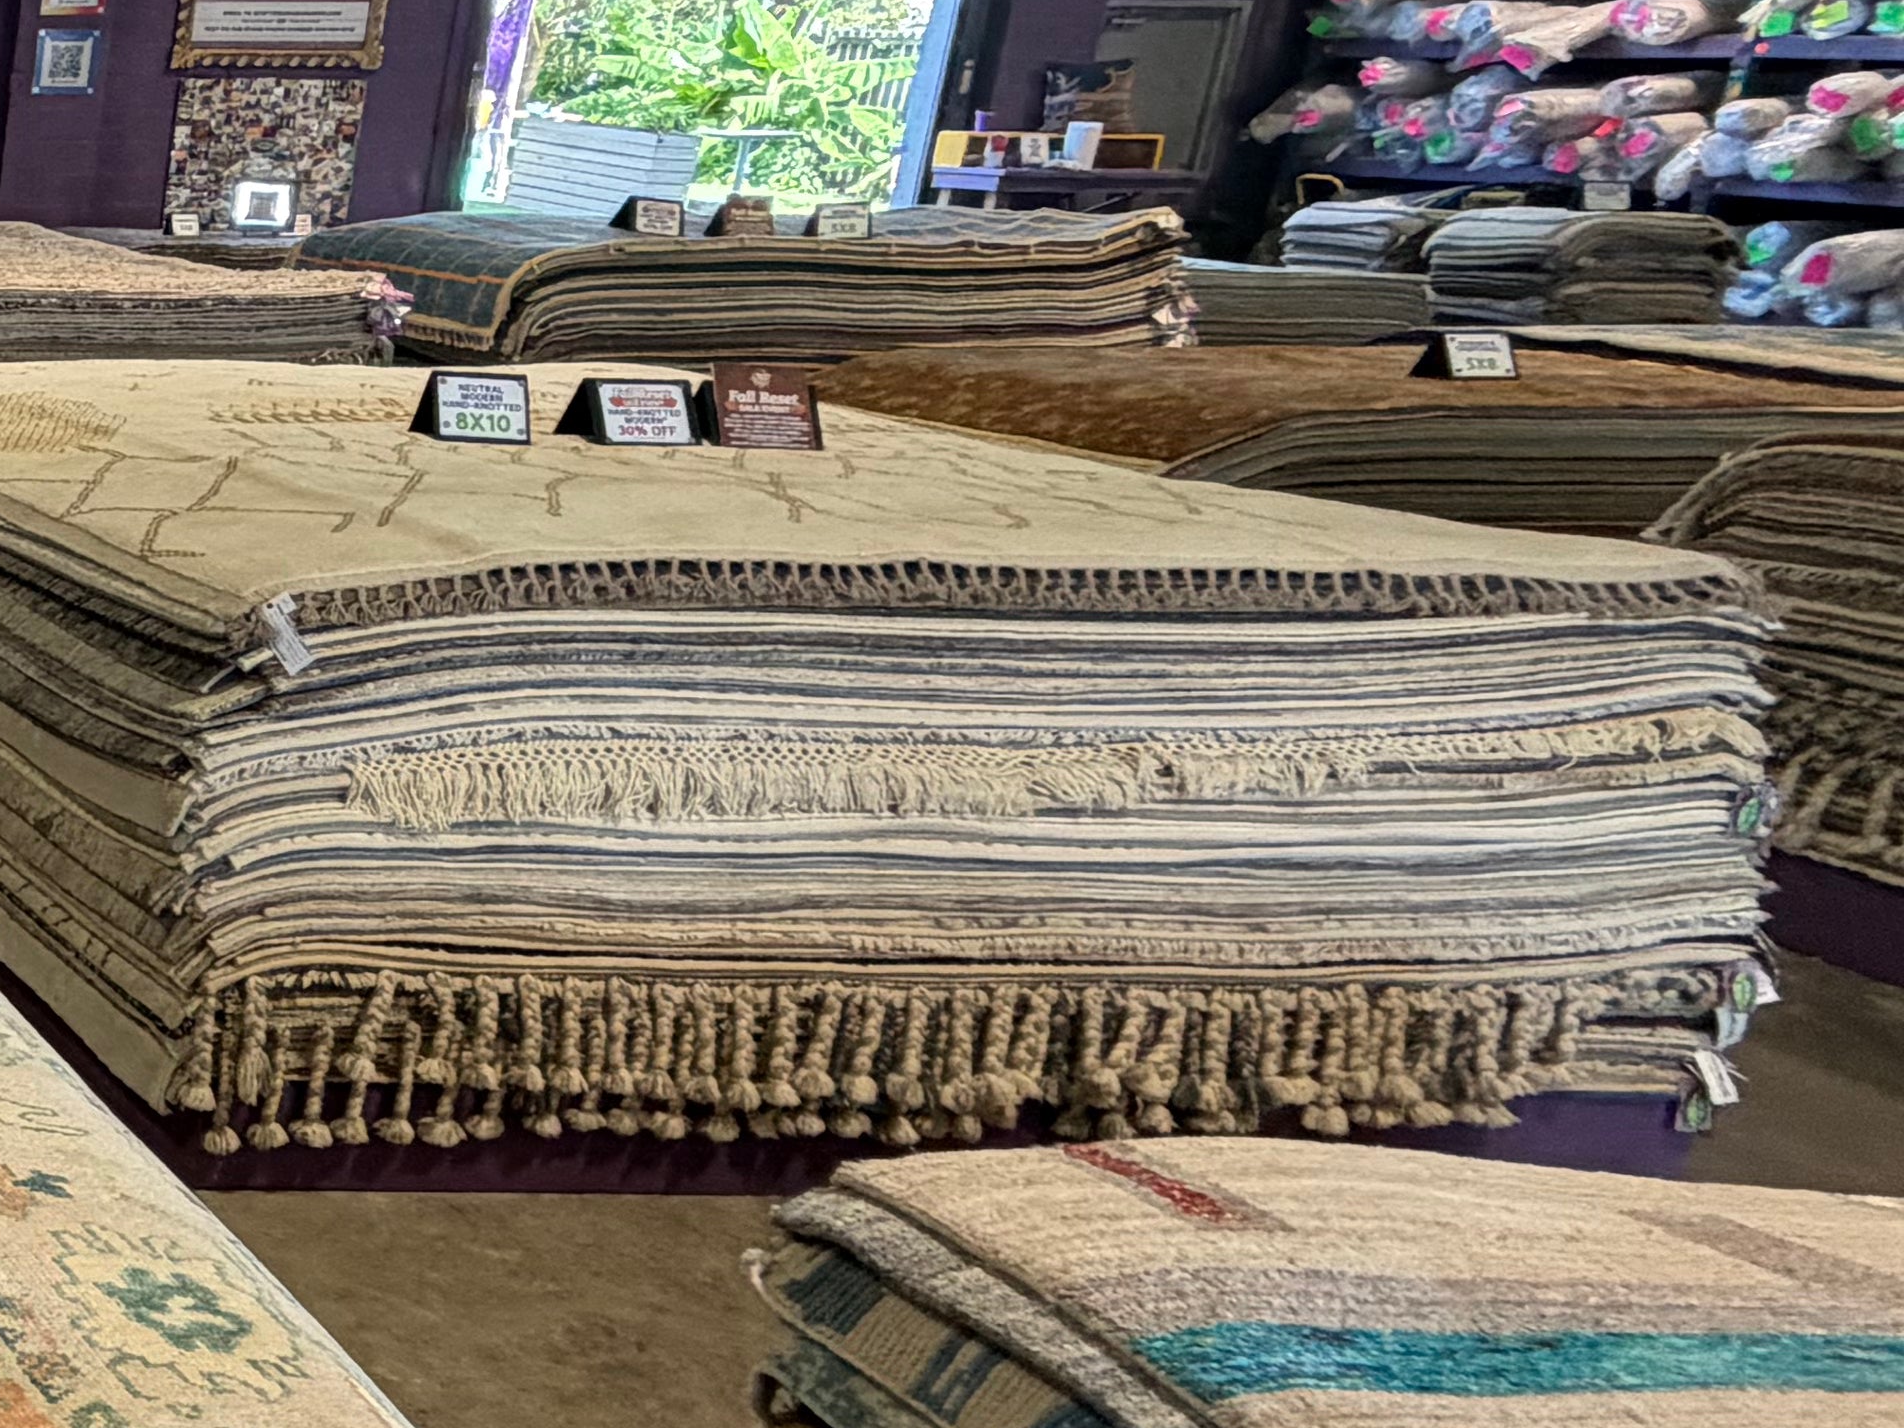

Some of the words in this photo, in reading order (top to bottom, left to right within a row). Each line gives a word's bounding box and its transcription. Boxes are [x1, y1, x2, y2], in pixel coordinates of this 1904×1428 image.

[458, 383, 504, 394] NEUTRAL
[460, 392, 503, 402] MODERN
[728, 389, 756, 403] Fall
[759, 390, 800, 405] Reset
[442, 400, 522, 412] HAND-KNOTTED
[455, 412, 511, 432] 8X10
[618, 425, 648, 436] 30%
[651, 426, 677, 437] OFF
